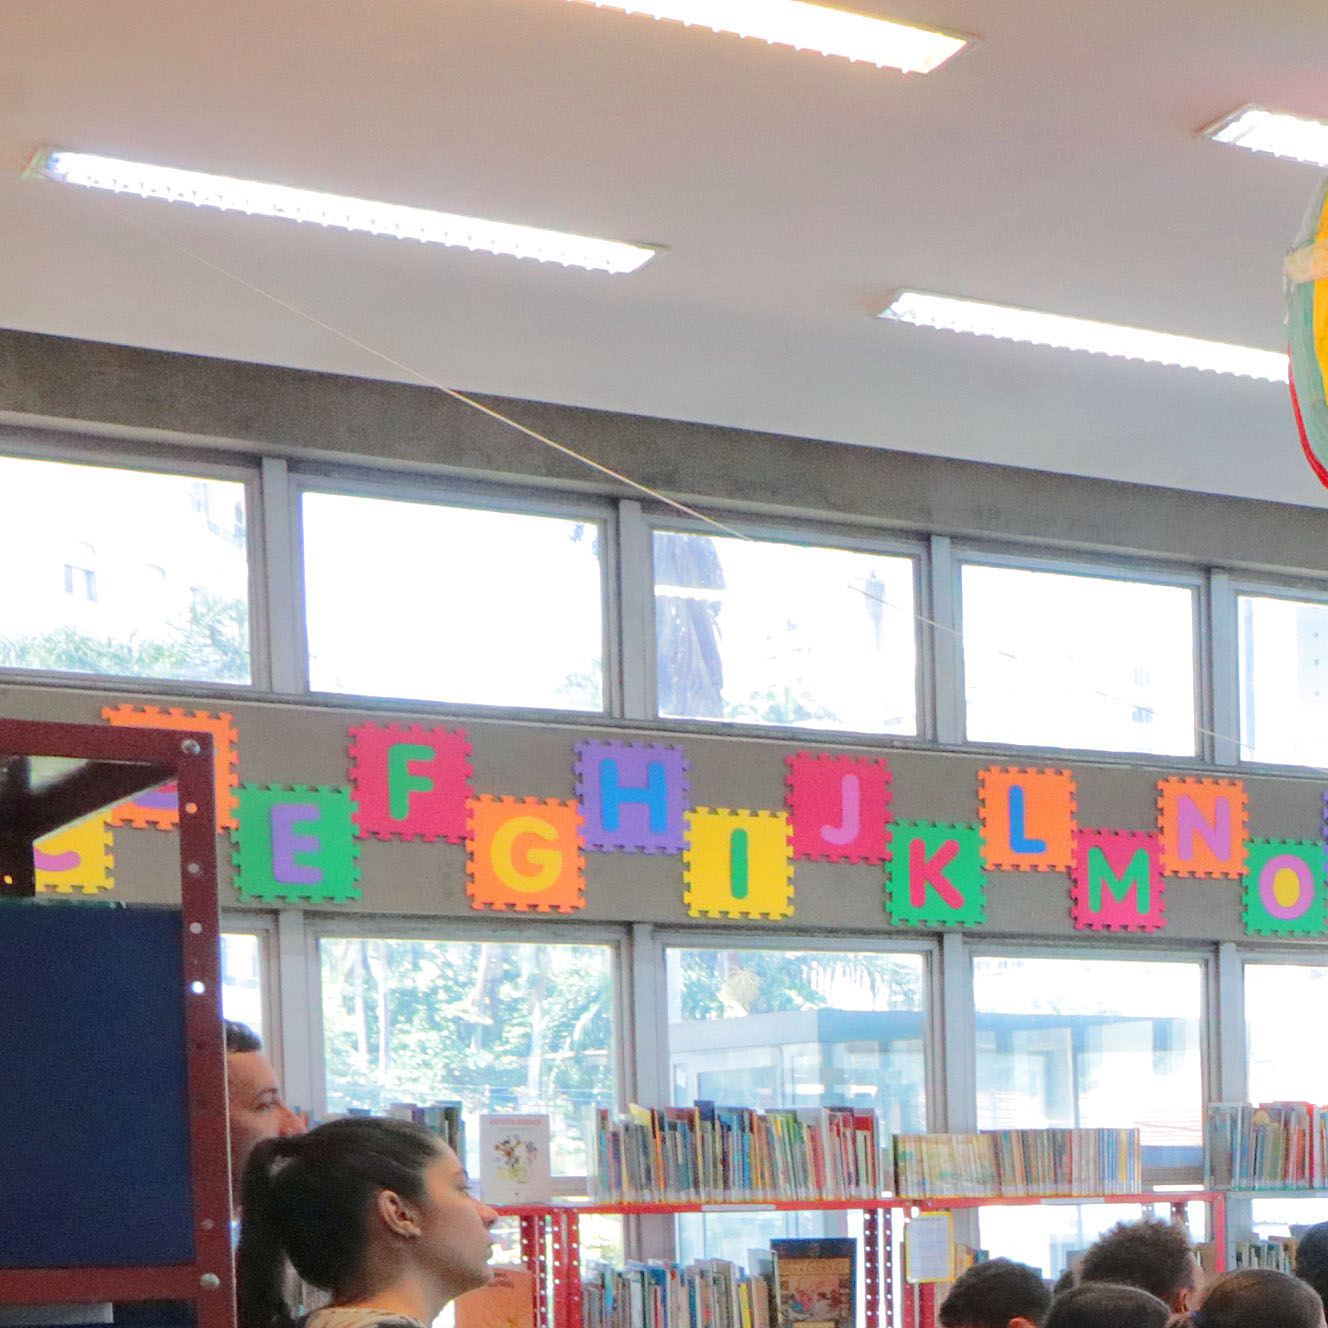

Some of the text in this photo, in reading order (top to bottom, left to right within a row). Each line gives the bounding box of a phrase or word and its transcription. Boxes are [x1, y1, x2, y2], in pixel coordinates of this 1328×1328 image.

[270, 804, 324, 884] E
[388, 743, 435, 821] F
[490, 817, 560, 893] G
[599, 757, 667, 836] H
[728, 828, 749, 900] I
[820, 775, 861, 846] J
[907, 838, 965, 910] K
[1008, 785, 1047, 855] L
[1088, 849, 1151, 915] M
[1177, 795, 1231, 861] N
[1258, 854, 1314, 920] O
